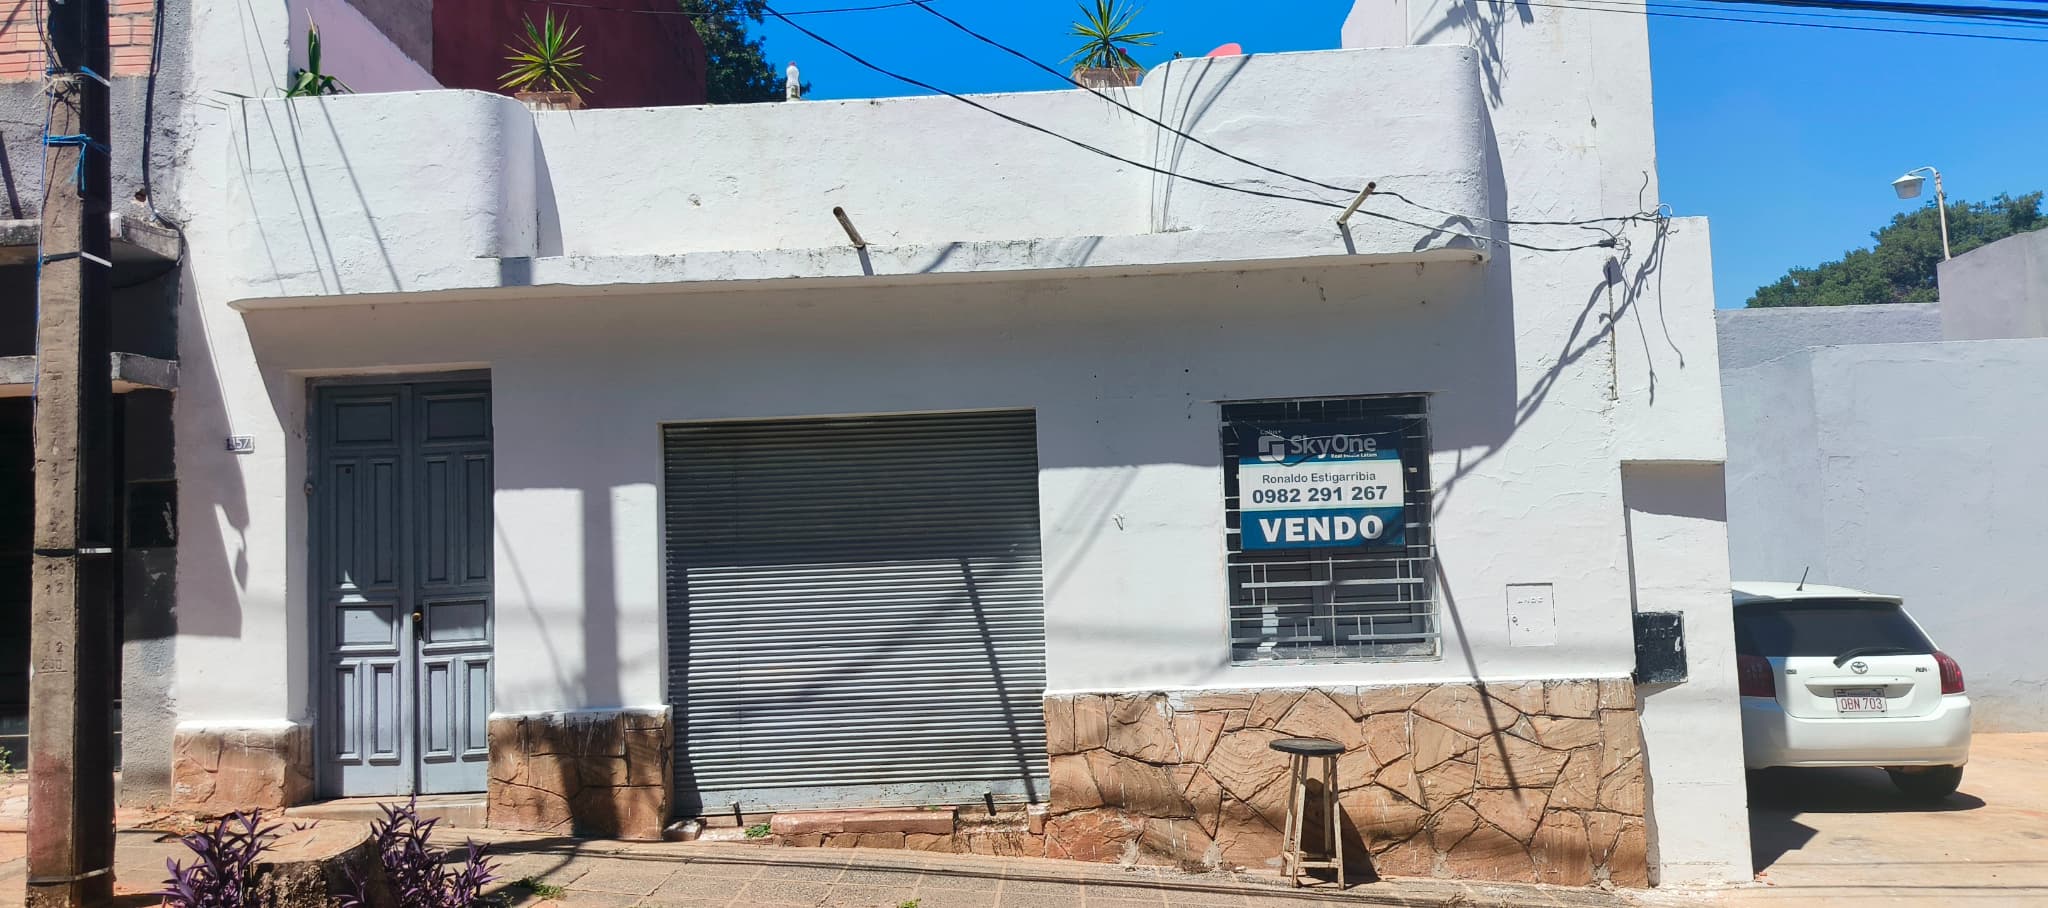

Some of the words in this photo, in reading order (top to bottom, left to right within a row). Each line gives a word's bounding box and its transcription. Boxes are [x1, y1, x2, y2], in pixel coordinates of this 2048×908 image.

[1290, 433, 1377, 459] SkyOne
[1262, 473, 1308, 484] Ronaldo
[1311, 471, 1376, 484] Estigarribia
[1252, 488, 1301, 504] 0982
[1307, 486, 1342, 502] 291
[1351, 485, 1388, 501] 267
[1258, 514, 1384, 543] VENDO
[1863, 697, 1883, 710] 703
